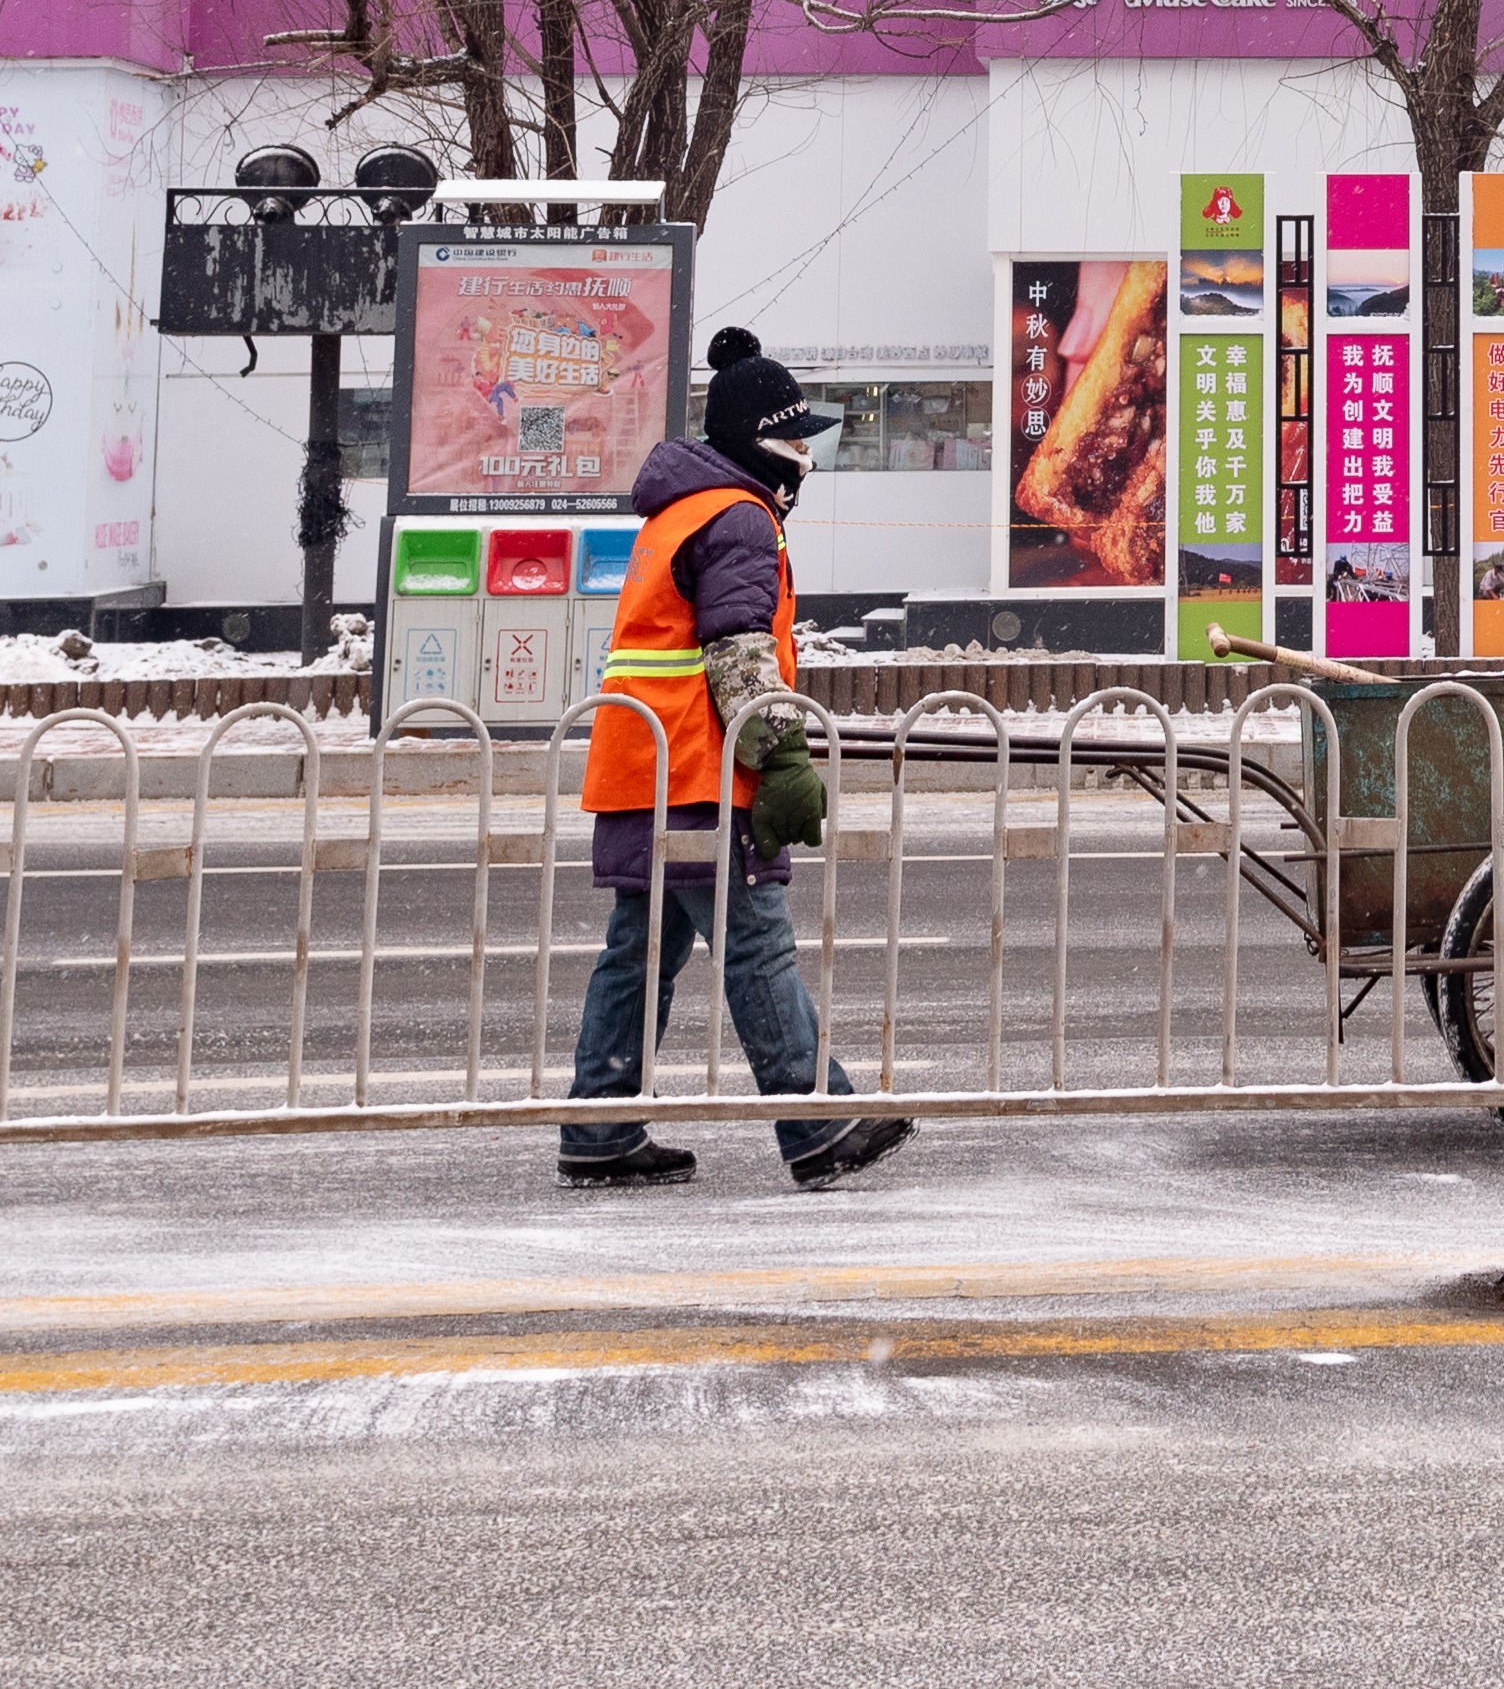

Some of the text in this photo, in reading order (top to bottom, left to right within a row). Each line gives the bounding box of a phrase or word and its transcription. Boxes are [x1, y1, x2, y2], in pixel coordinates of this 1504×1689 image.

[462, 226, 629, 241] 智慧城市太阳能广告箱
[507, 359, 600, 386] 美好生活
[1025, 280, 1050, 436] 中秋有妙思
[1194, 344, 1218, 535] 文明关乎你我他
[1225, 344, 1248, 534] 幸福惠及千万家
[1342, 344, 1365, 534] 我为创建出把力
[1371, 344, 1395, 534] 抚顺文明我受益
[480, 455, 601, 478] 100元礼包
